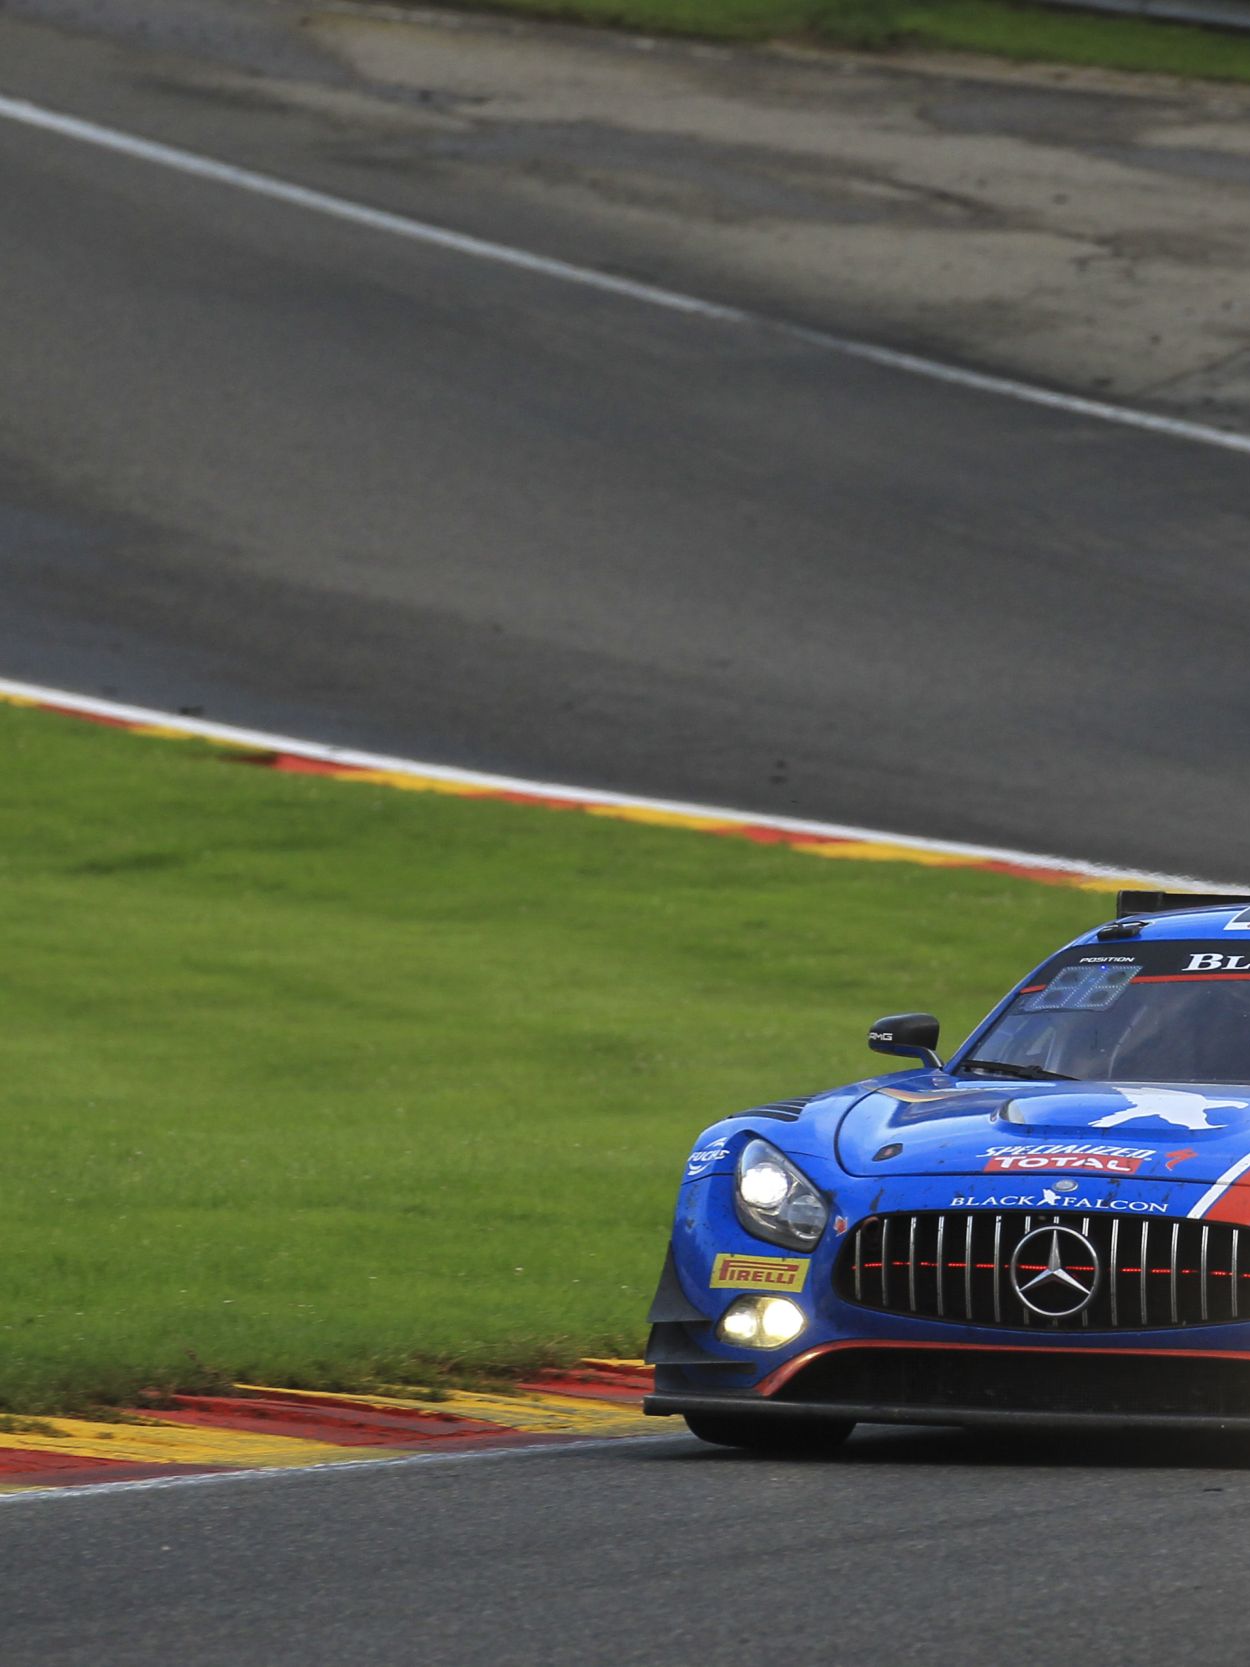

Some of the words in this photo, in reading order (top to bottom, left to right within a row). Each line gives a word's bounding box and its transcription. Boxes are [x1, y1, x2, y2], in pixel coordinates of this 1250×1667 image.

[687, 1149, 730, 1162] FUCHS
[976, 1144, 1157, 1161] SPECIALIZED
[994, 1155, 1132, 1172] TOTAL
[950, 1194, 1037, 1208] BLACK
[1063, 1197, 1169, 1213] FALCON
[718, 1258, 800, 1285] PIRELLI
